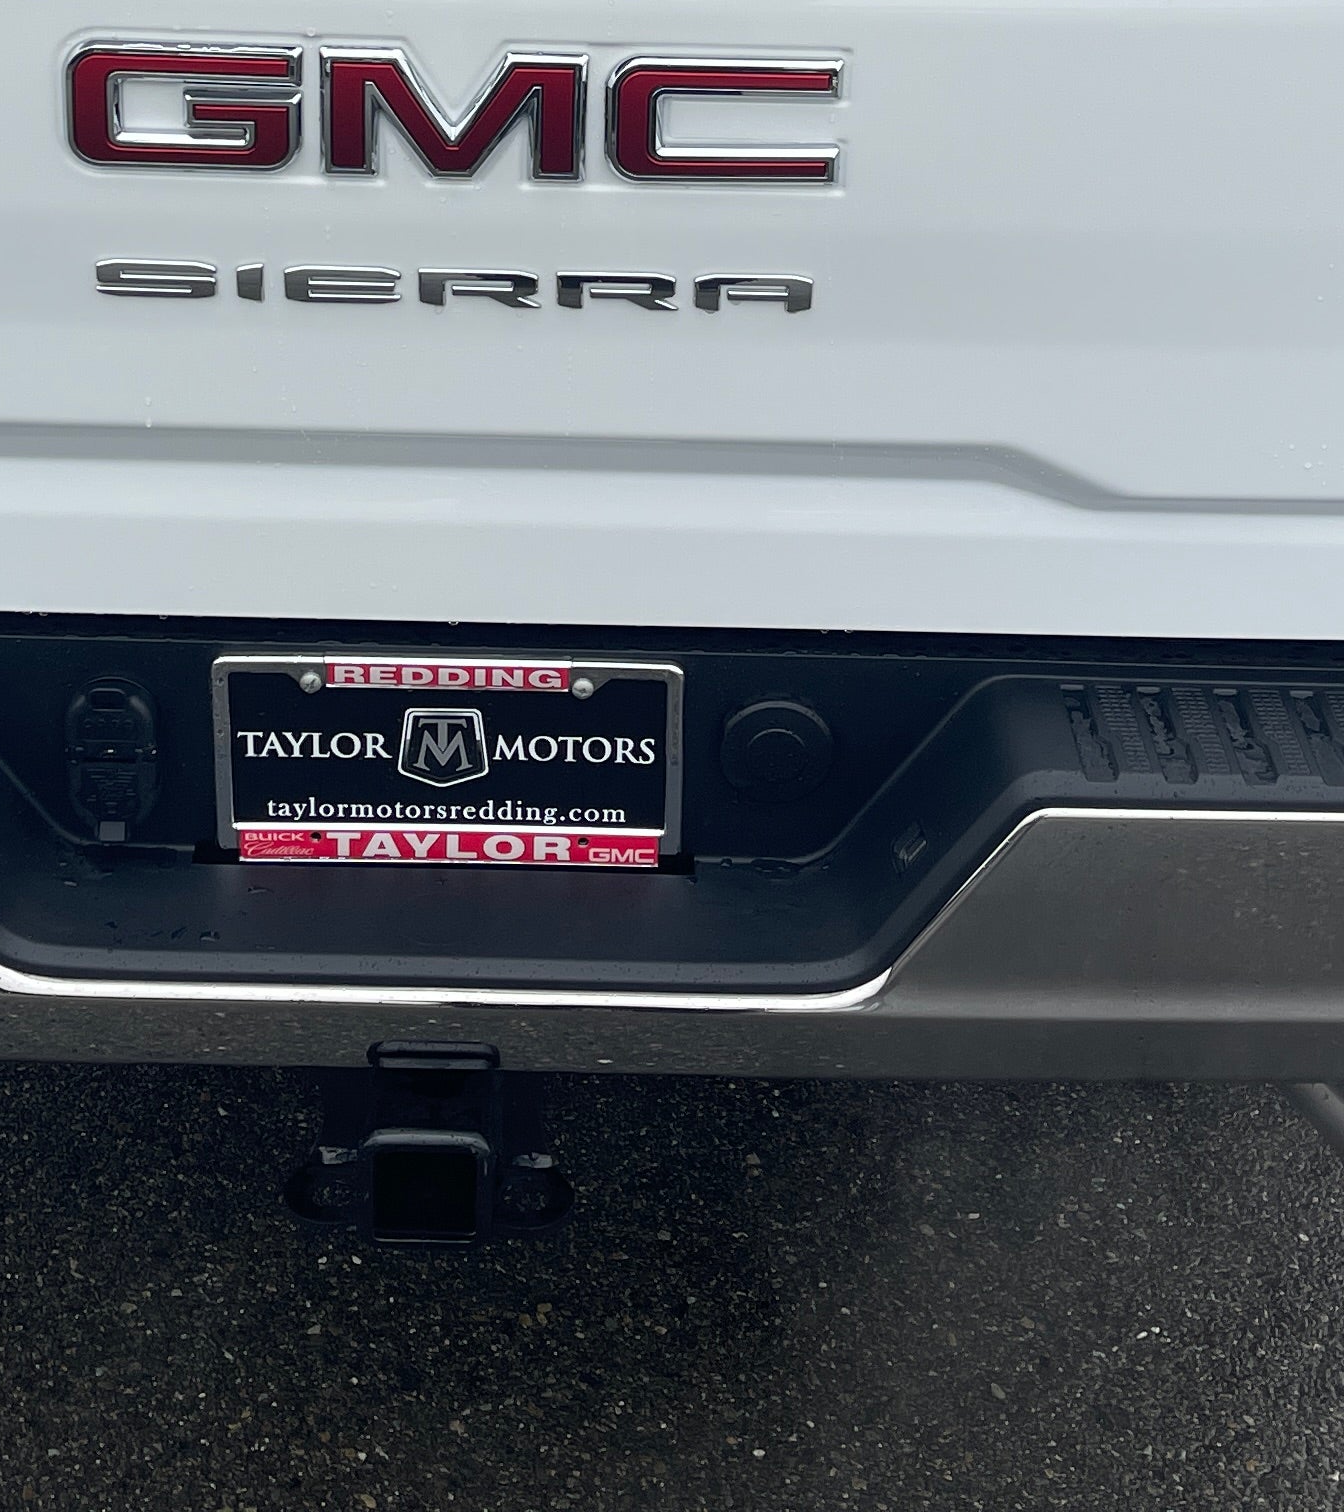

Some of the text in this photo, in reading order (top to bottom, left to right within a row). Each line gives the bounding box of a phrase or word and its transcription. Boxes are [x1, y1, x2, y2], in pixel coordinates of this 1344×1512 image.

[66, 40, 846, 184] GMC
[96, 257, 814, 315] SIERRA
[333, 665, 563, 689] REDDING
[237, 731, 656, 765] TAYLOR MOTORS
[266, 797, 627, 825] taylormotorsredding.com
[243, 840, 315, 857] Cadillac
[244, 832, 305, 842] BUICK
[326, 832, 572, 863] TAYLOR
[588, 848, 656, 865] GMC
